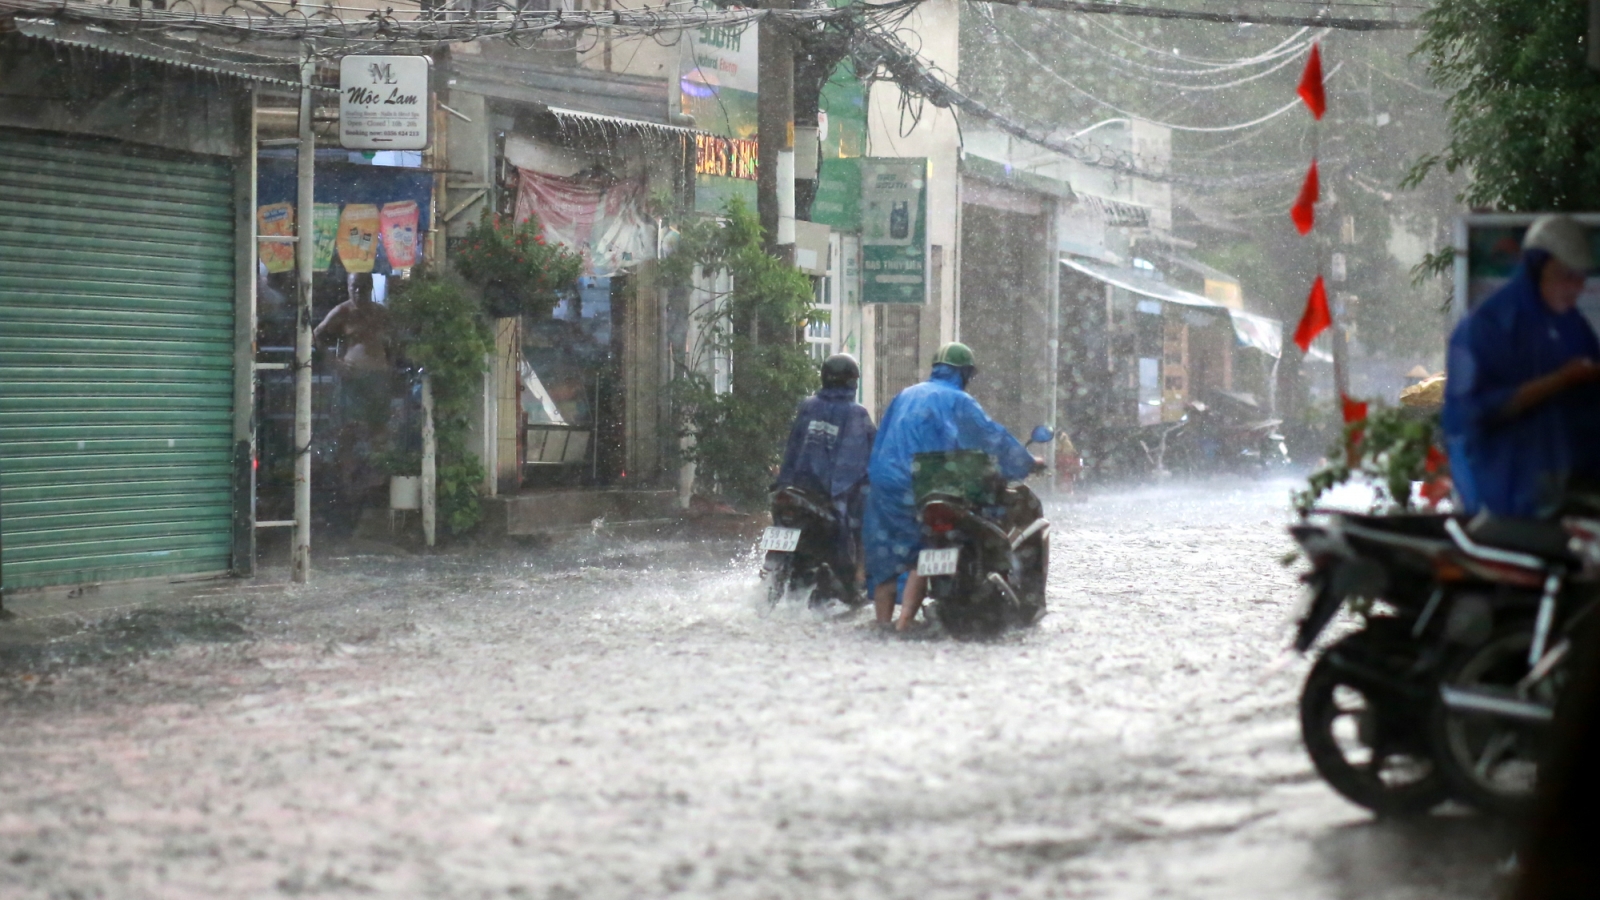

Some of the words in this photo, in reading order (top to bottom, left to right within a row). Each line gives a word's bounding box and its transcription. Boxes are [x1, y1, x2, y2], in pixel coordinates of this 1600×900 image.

[697, 25, 741, 53] SOUTH
[720, 57, 738, 77] Energy
[347, 86, 380, 109] Mộc
[383, 87, 418, 105] Lam
[695, 134, 727, 177] GAS
